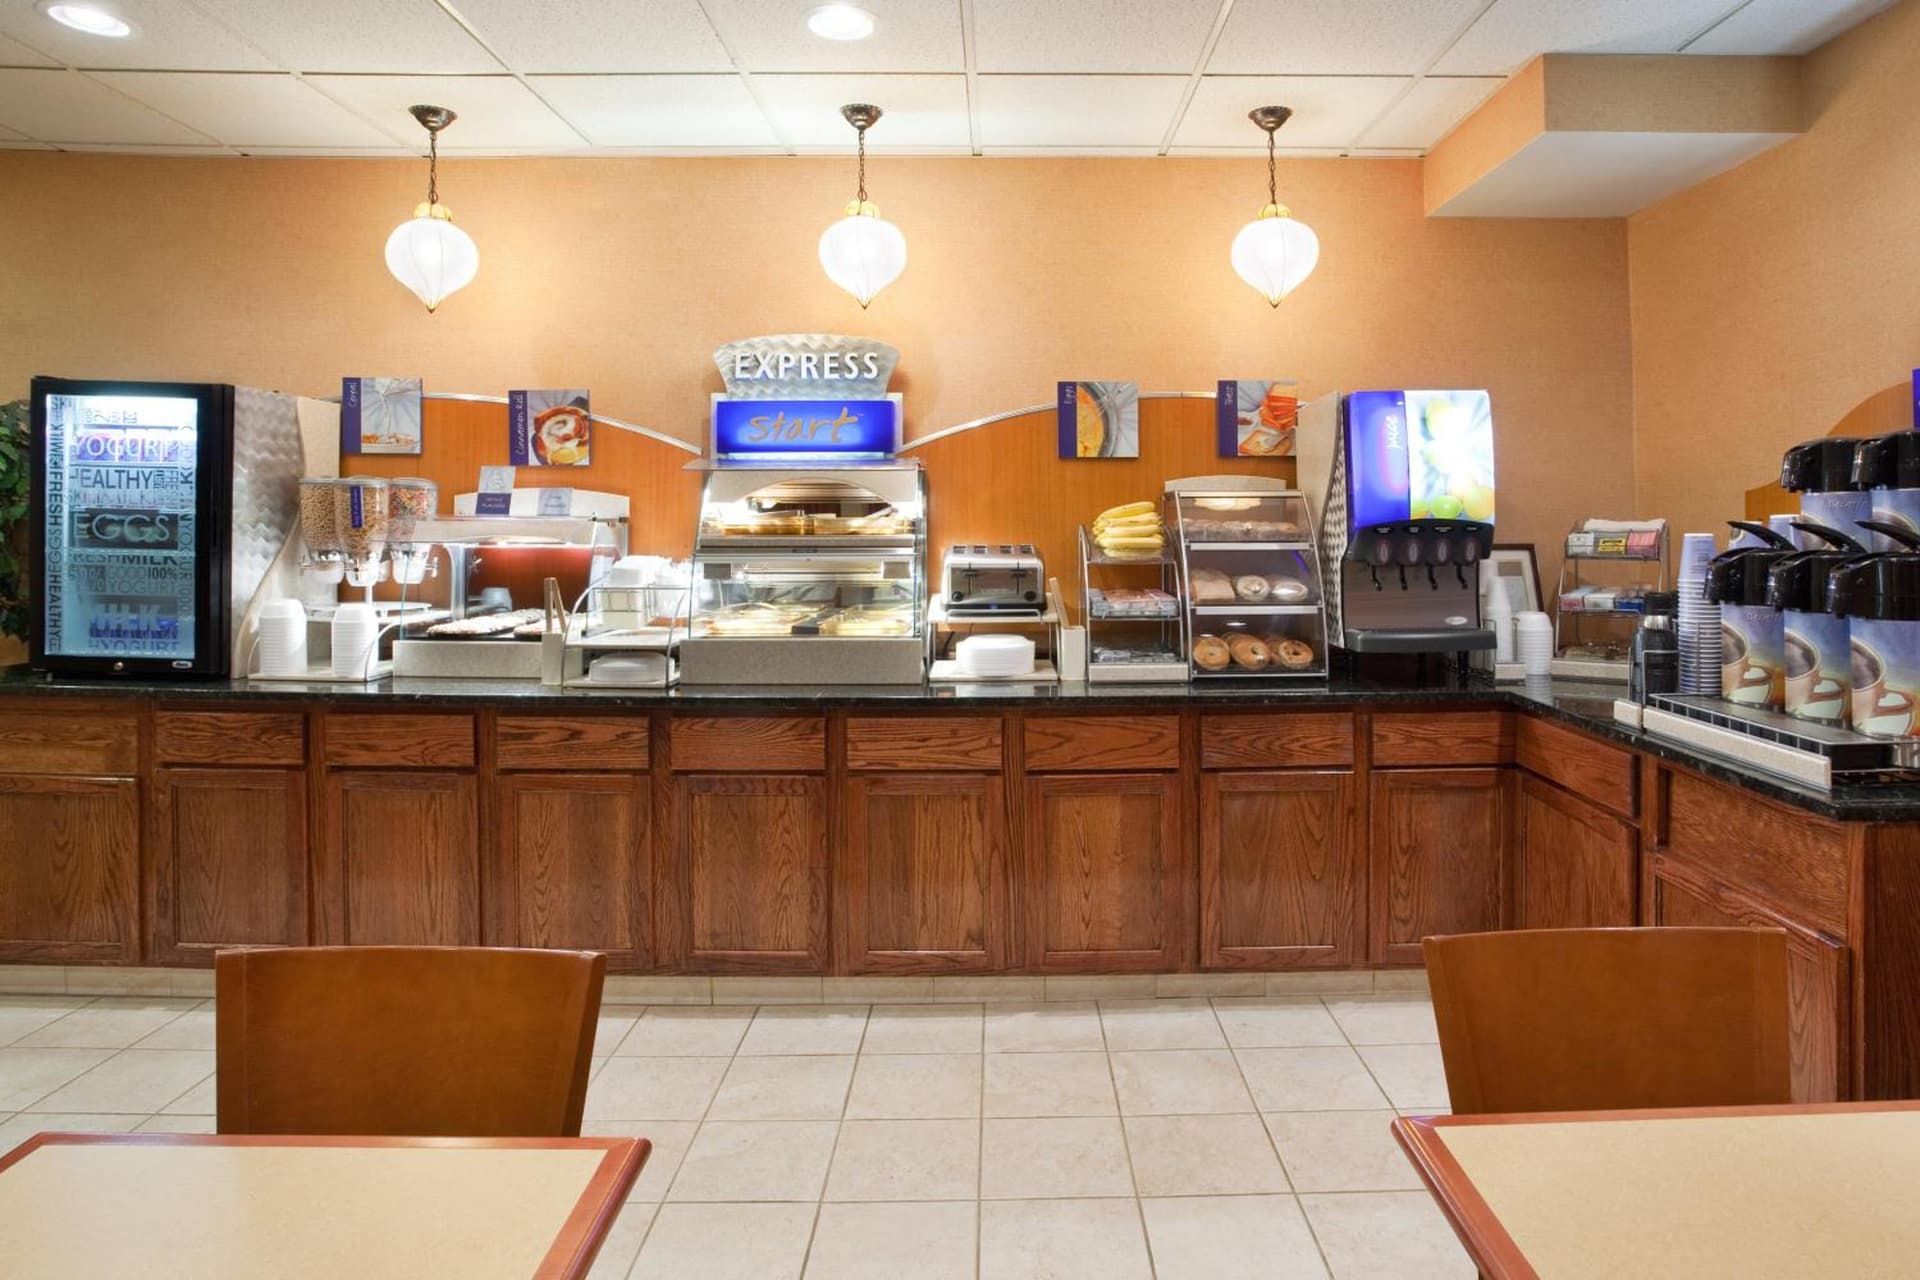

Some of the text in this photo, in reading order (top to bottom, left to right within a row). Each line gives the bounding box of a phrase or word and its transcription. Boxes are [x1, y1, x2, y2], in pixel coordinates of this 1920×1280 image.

[734, 351, 879, 380] EXPRESS
[748, 407, 859, 443] start
[49, 471, 63, 526] FRESH
[75, 514, 170, 542] EGGS
[48, 528, 62, 573] EGGS
[48, 574, 62, 638] HEALTHY
